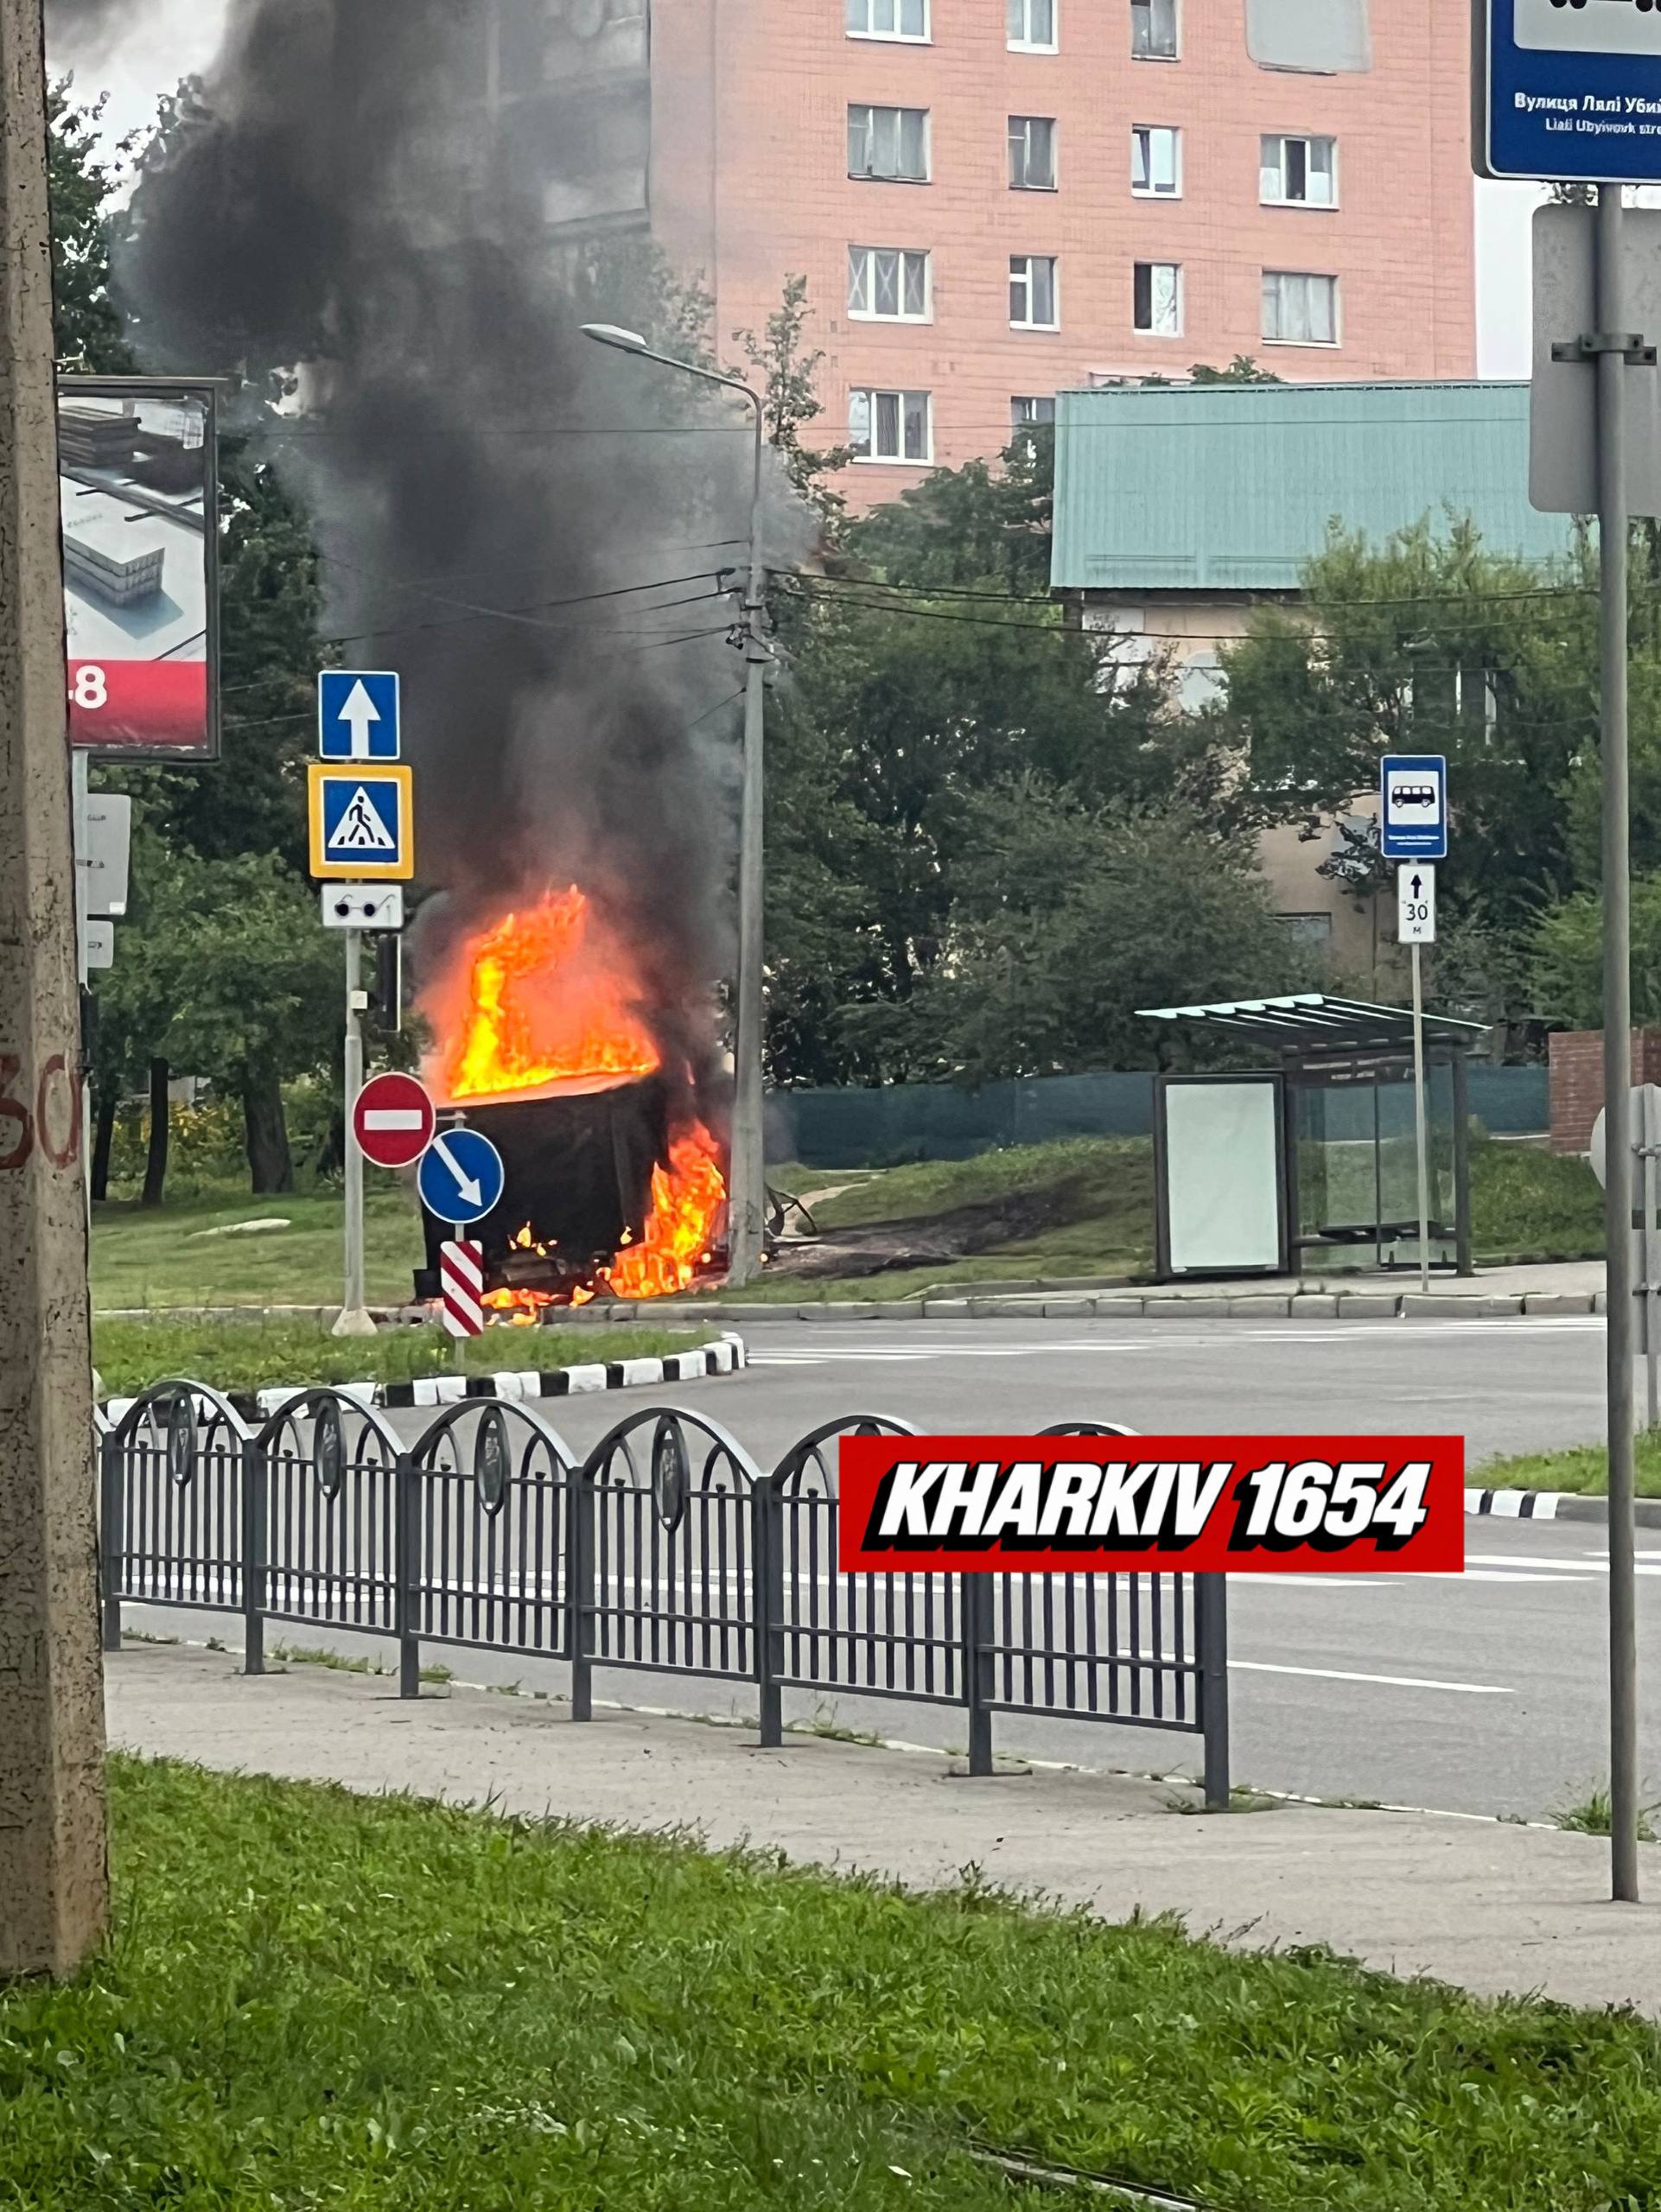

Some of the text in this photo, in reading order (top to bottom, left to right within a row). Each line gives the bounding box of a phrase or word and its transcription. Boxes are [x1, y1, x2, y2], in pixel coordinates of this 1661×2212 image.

[1514, 92, 1578, 112] Вулиця
[1582, 95, 1621, 112] Лялі
[1405, 903, 1429, 921] 30
